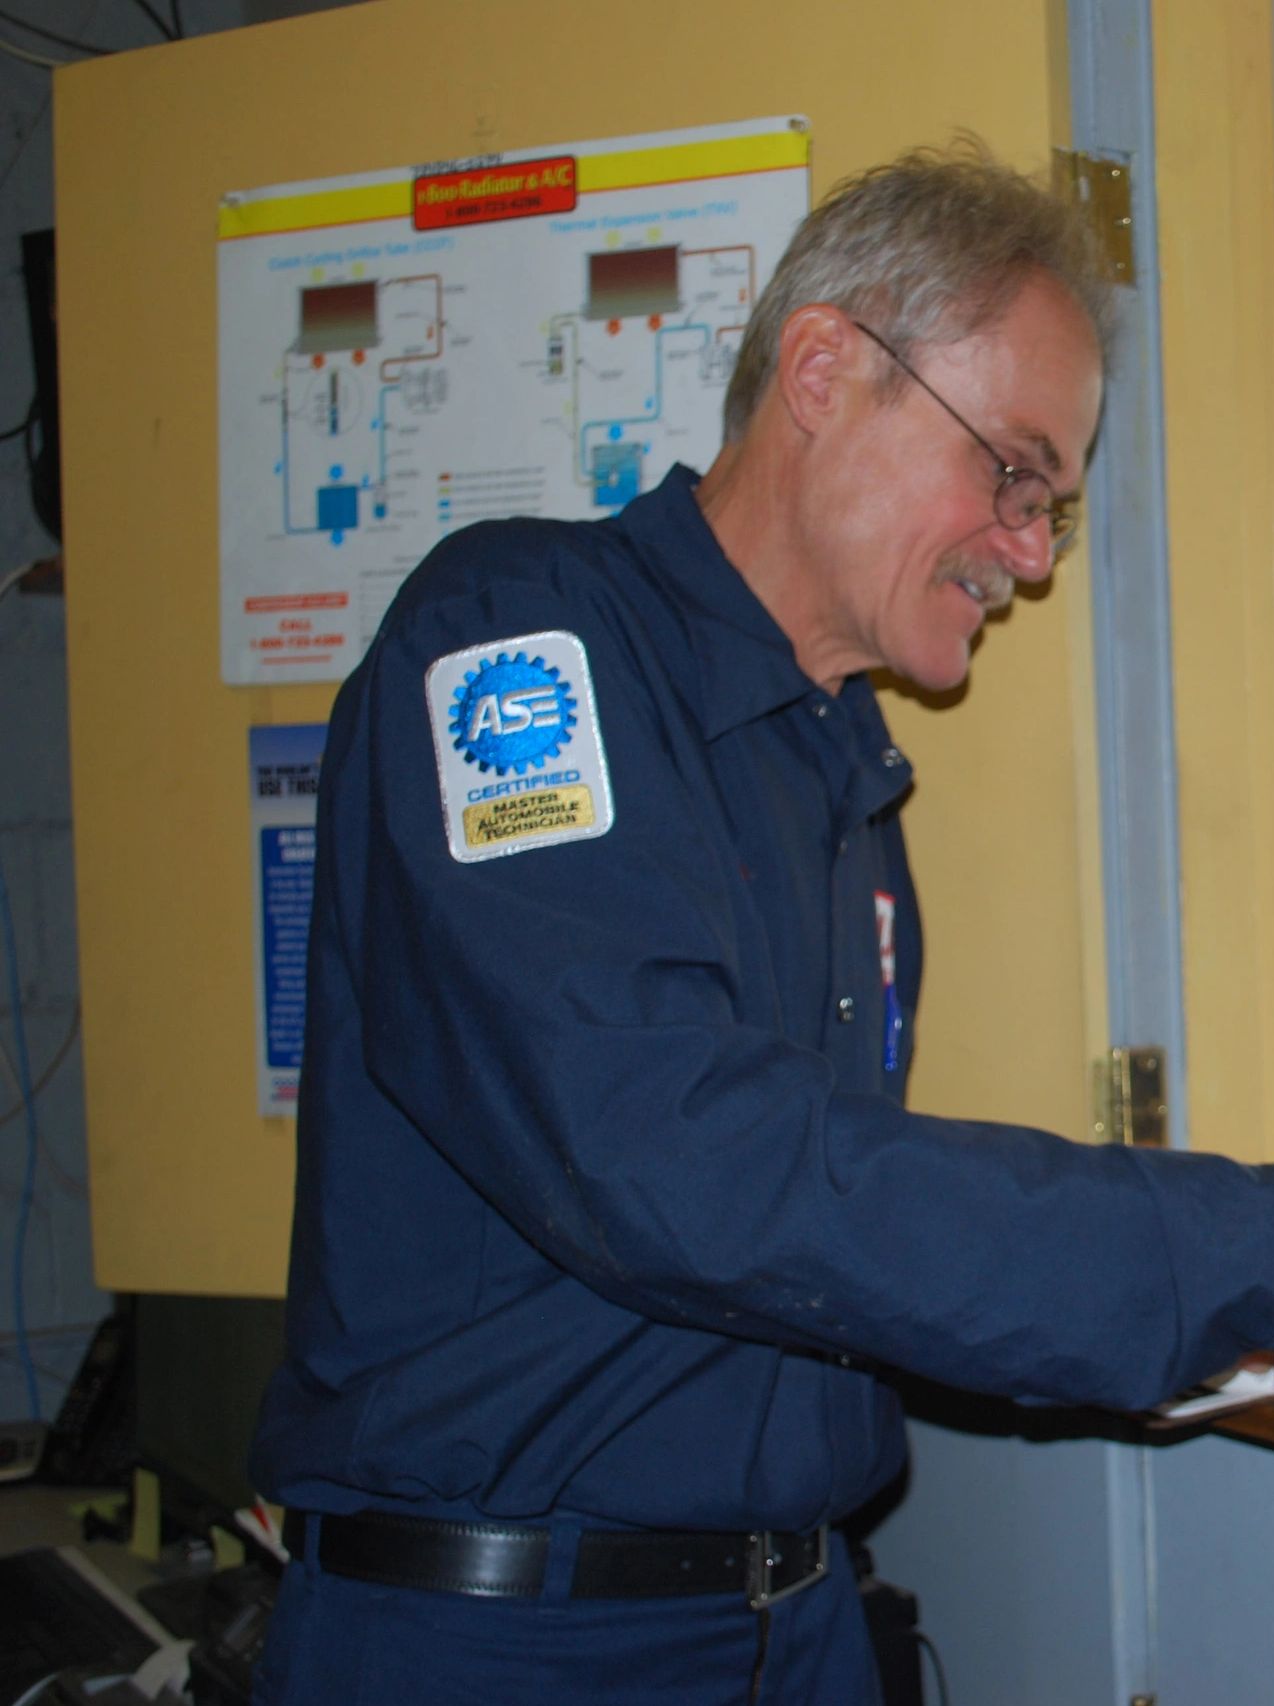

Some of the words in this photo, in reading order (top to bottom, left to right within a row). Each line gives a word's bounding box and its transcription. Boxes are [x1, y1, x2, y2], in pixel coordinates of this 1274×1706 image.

[467, 685, 561, 742] ASE
[467, 769, 581, 802] CERTIFIED
[478, 800, 579, 831] AUTOMOBILE
[493, 791, 558, 813] MASTER
[483, 814, 577, 841] TECHNICIAN
